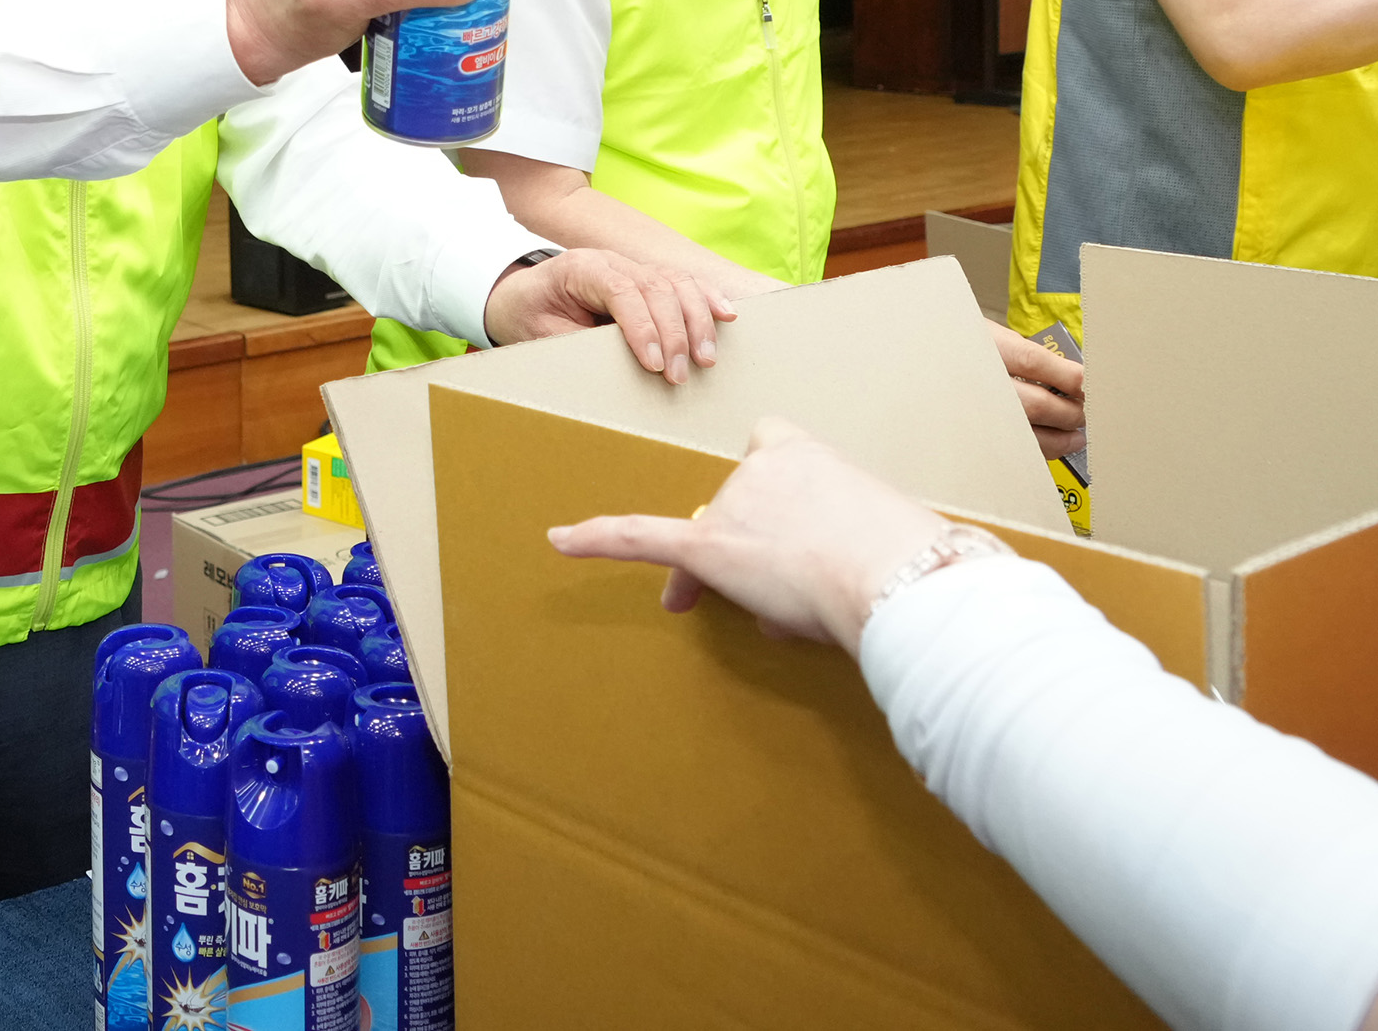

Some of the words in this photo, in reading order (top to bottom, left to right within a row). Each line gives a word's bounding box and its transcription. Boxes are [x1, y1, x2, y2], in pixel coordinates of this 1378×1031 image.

[462, 26, 493, 44] 빠르고
[243, 877, 265, 894] No.1
[175, 942, 192, 956] 수성
